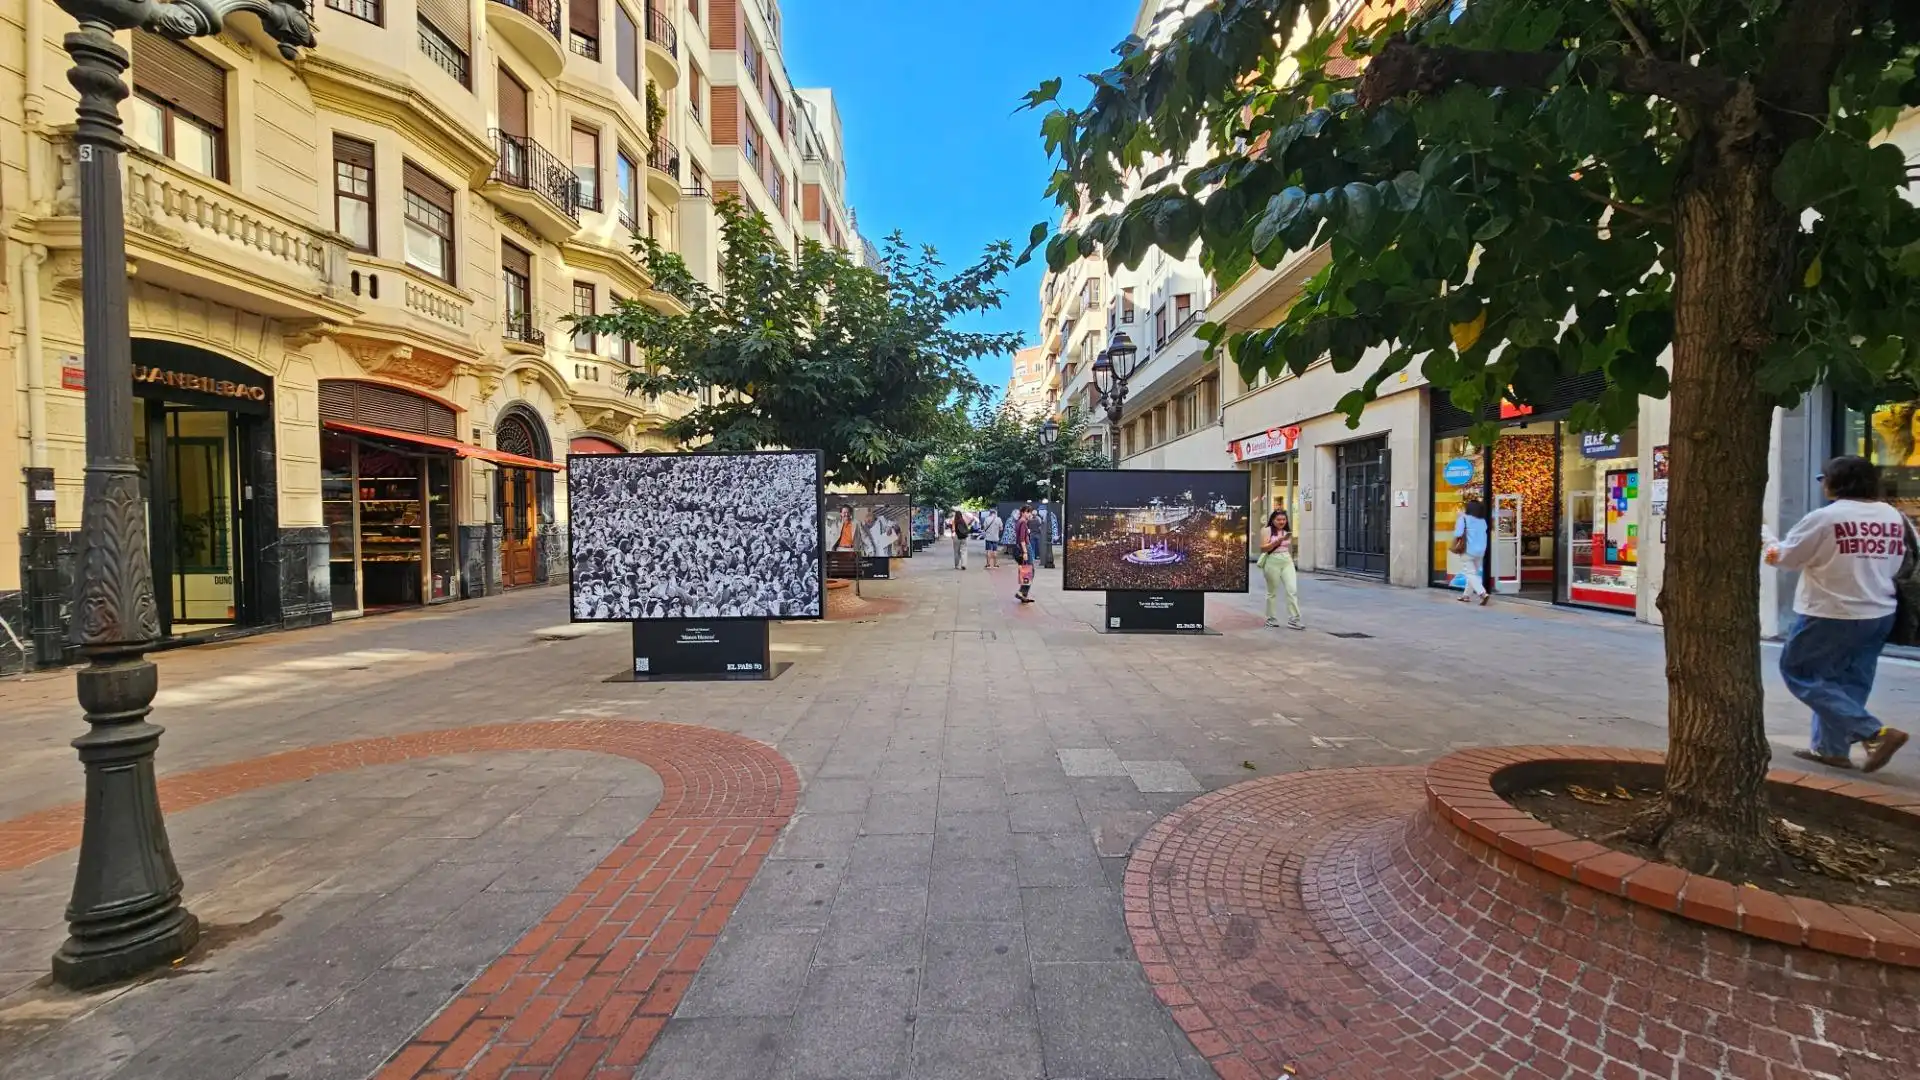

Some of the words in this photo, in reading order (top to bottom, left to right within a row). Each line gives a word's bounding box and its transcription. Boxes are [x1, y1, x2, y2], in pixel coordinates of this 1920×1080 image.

[132, 363, 265, 400] UANBILBAO
[1834, 521, 1857, 538] AU
[1860, 522, 1902, 537] SOLEI
[737, 662, 753, 670] PAÍS
